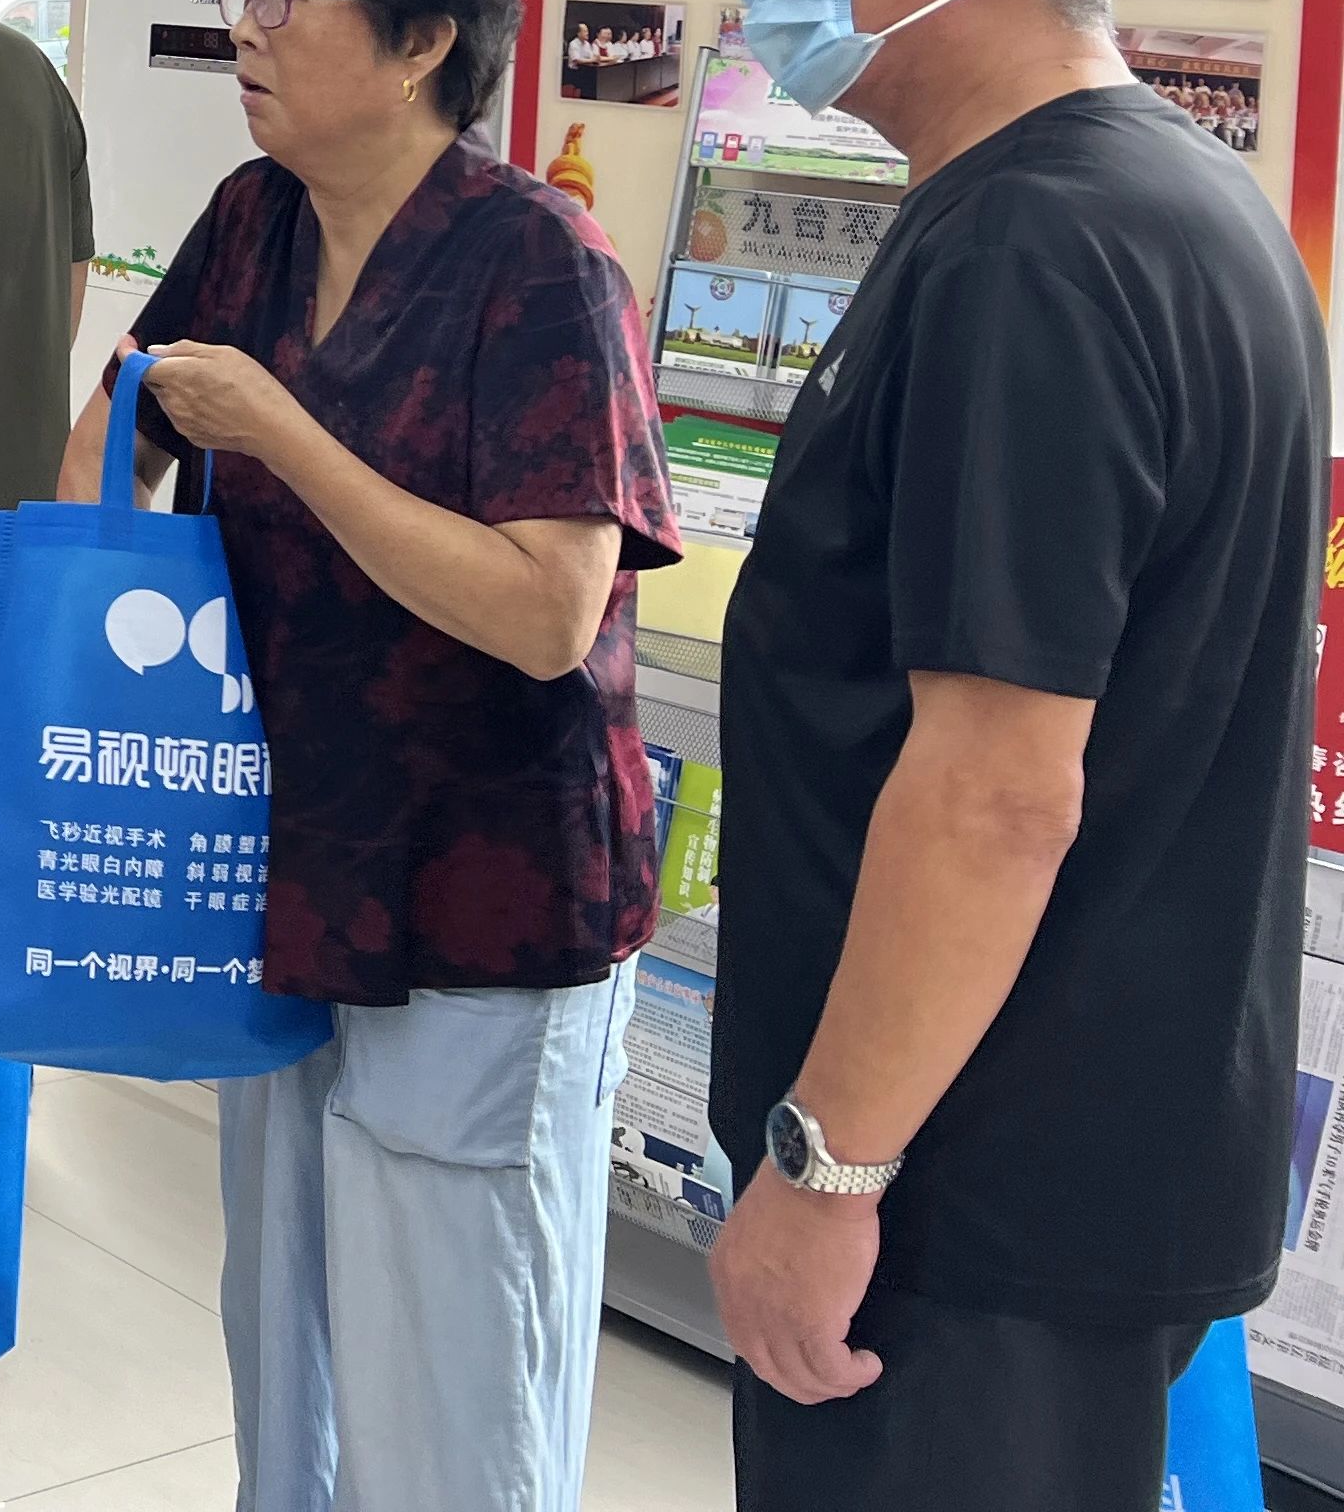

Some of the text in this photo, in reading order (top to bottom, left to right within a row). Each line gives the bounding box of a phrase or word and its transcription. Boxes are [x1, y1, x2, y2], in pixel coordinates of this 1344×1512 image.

[39, 725, 273, 796] 易视顿眼
[39, 818, 167, 849] 飞秒近视手术
[38, 849, 165, 881] 青光眼白内障
[36, 879, 163, 910] 医学验光配镜
